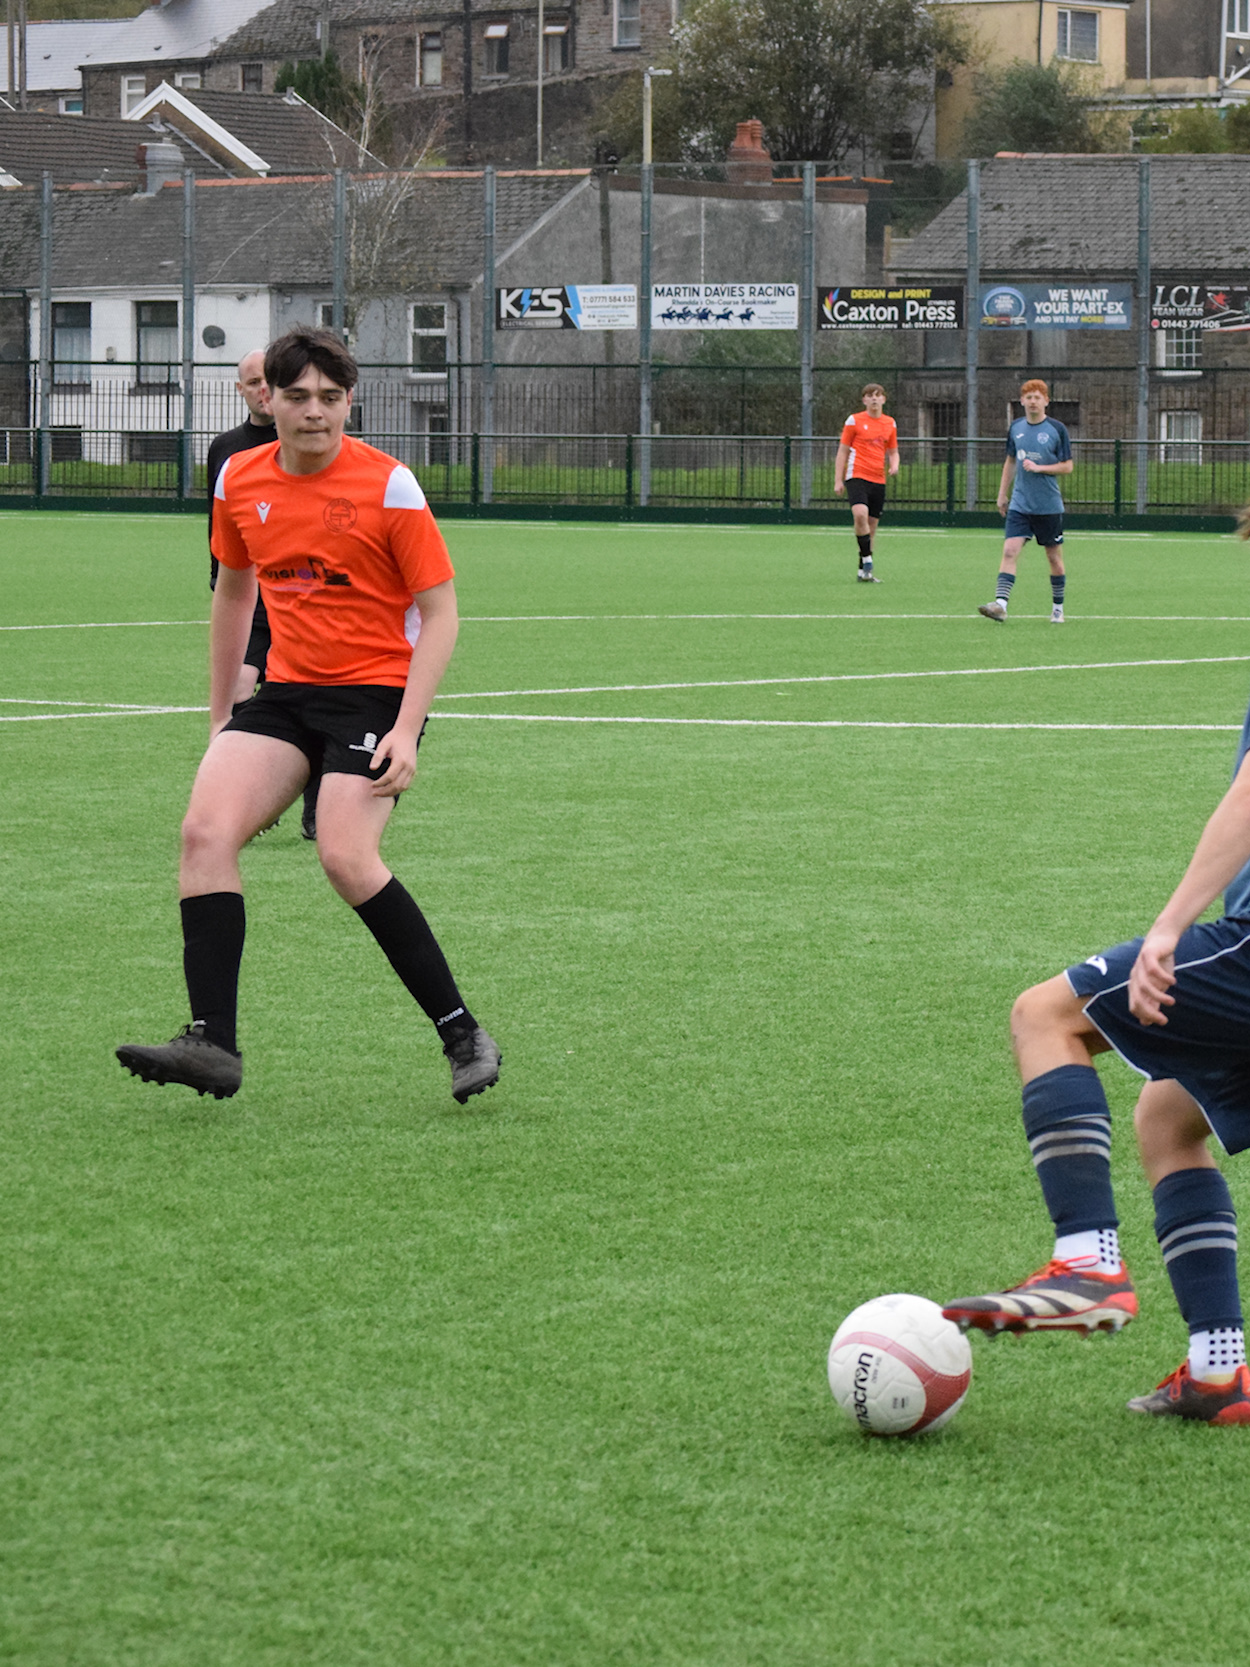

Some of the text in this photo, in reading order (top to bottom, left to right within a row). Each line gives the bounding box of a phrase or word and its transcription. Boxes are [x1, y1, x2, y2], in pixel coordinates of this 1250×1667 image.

[654, 286, 796, 297] MARTIN DAVIES RACING
[850, 289, 932, 299] DESIGN and PRINT
[1048, 289, 1109, 301] WE WANT
[1152, 285, 1205, 308] LCL
[500, 288, 564, 318] KES
[1034, 302, 1124, 314] YOUR PART-EX
[832, 300, 956, 321] Caxton Press
[1152, 307, 1204, 316] TEAM WEAR
[1034, 315, 1052, 324] AND
[1052, 315, 1065, 324] WE
[1065, 315, 1080, 324] PAY
[1161, 319, 1188, 329] 01443
